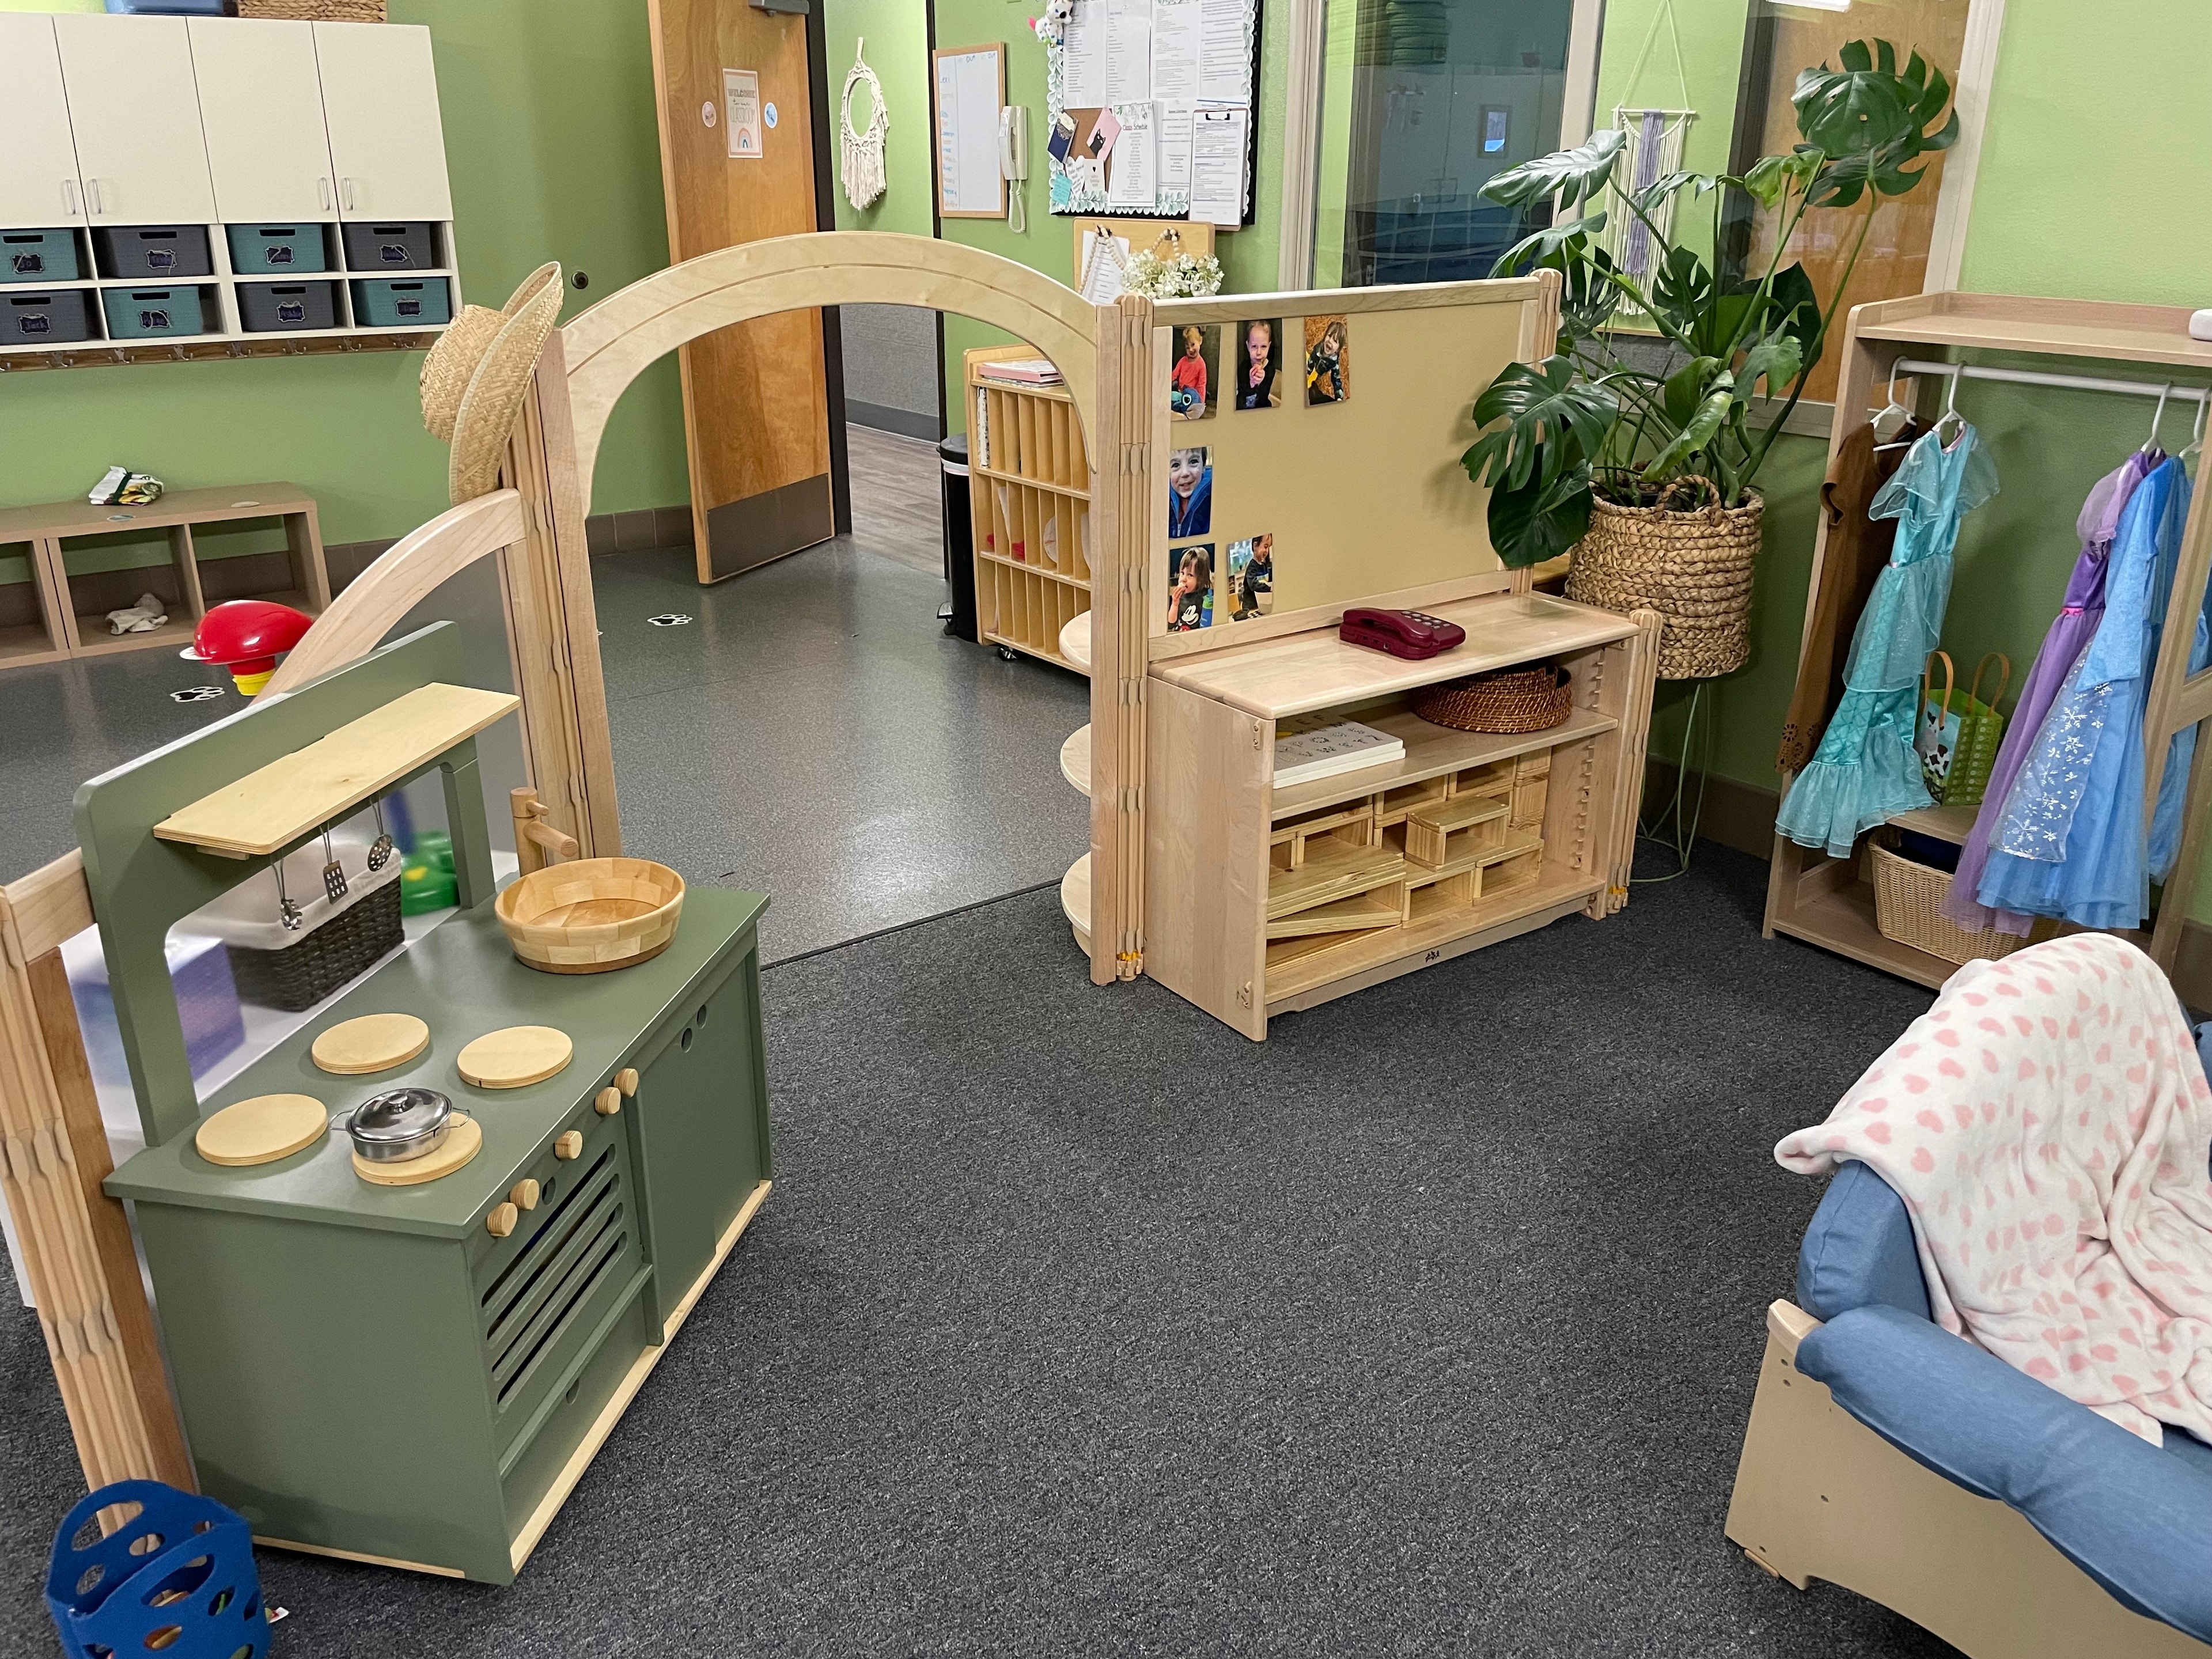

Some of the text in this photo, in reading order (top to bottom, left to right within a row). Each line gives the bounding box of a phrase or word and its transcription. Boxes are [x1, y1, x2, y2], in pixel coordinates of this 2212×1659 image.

[728, 89, 755, 98] WELCOME
[730, 108, 756, 124] CLASSROOM
[25, 320, 47, 330] Jack
